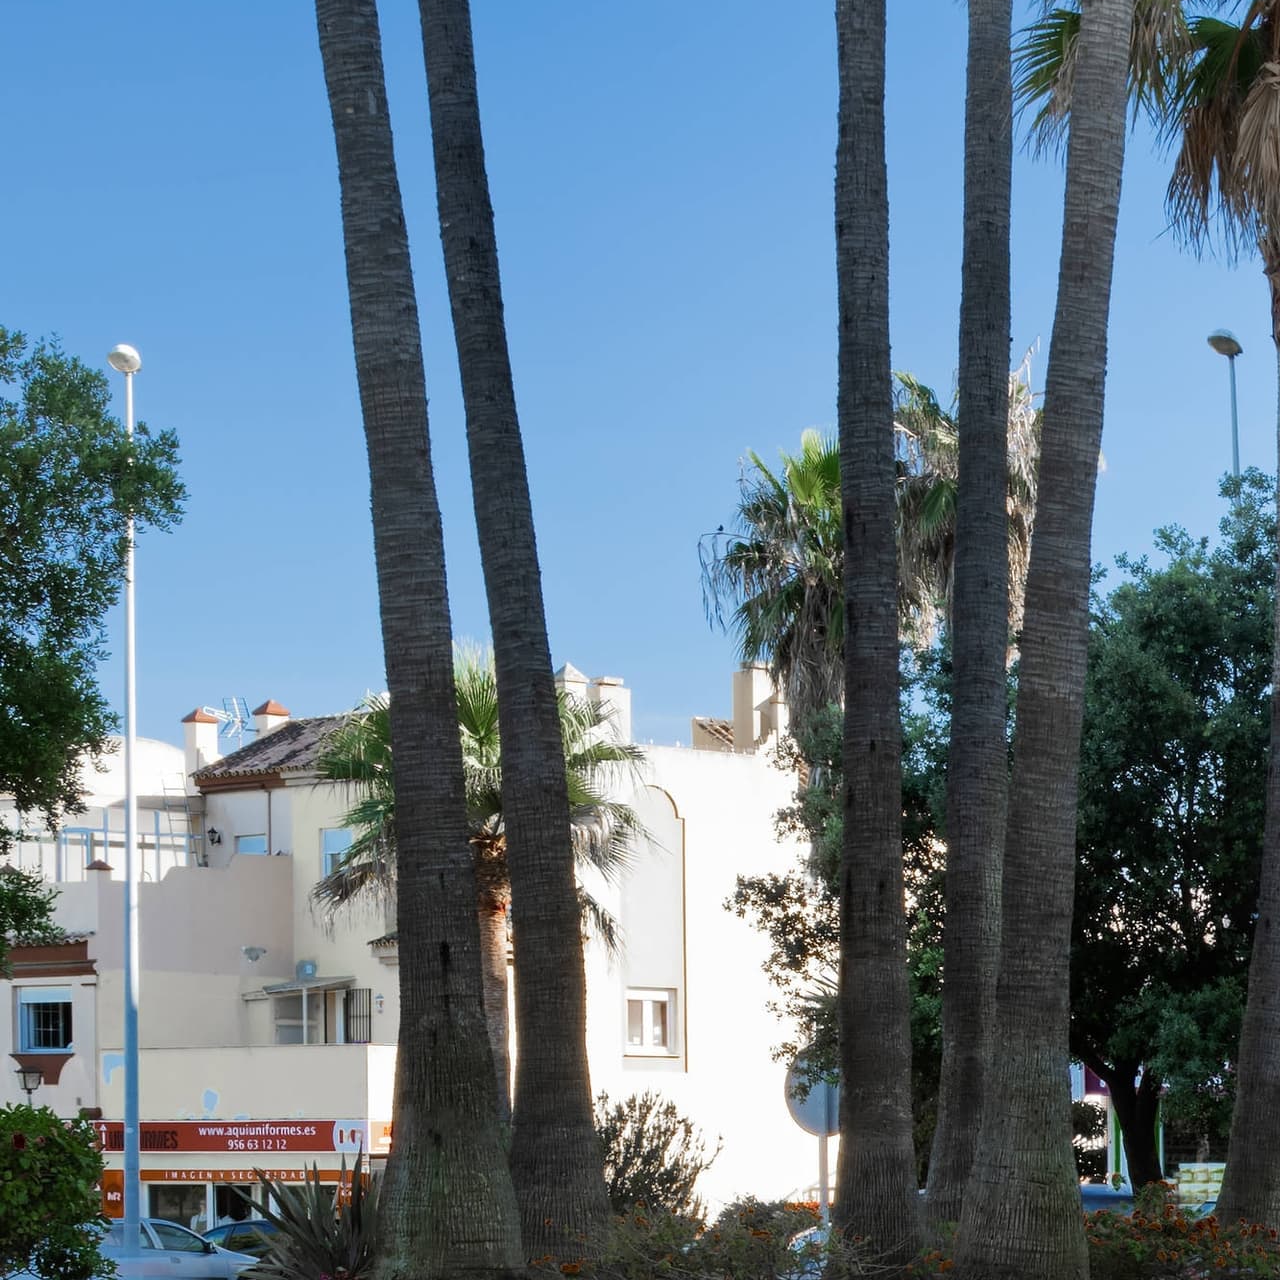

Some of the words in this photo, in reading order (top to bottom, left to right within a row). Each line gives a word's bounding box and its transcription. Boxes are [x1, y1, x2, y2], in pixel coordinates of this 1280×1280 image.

[198, 1123, 316, 1137] www.aquiuniformes.es
[227, 1139, 245, 1150] 956
[247, 1139, 259, 1150] 63
[262, 1139, 272, 1150] 12
[276, 1139, 287, 1150] 12
[165, 1171, 212, 1179] IMAGEN
[231, 1171, 305, 1180] SEGRIDAD
